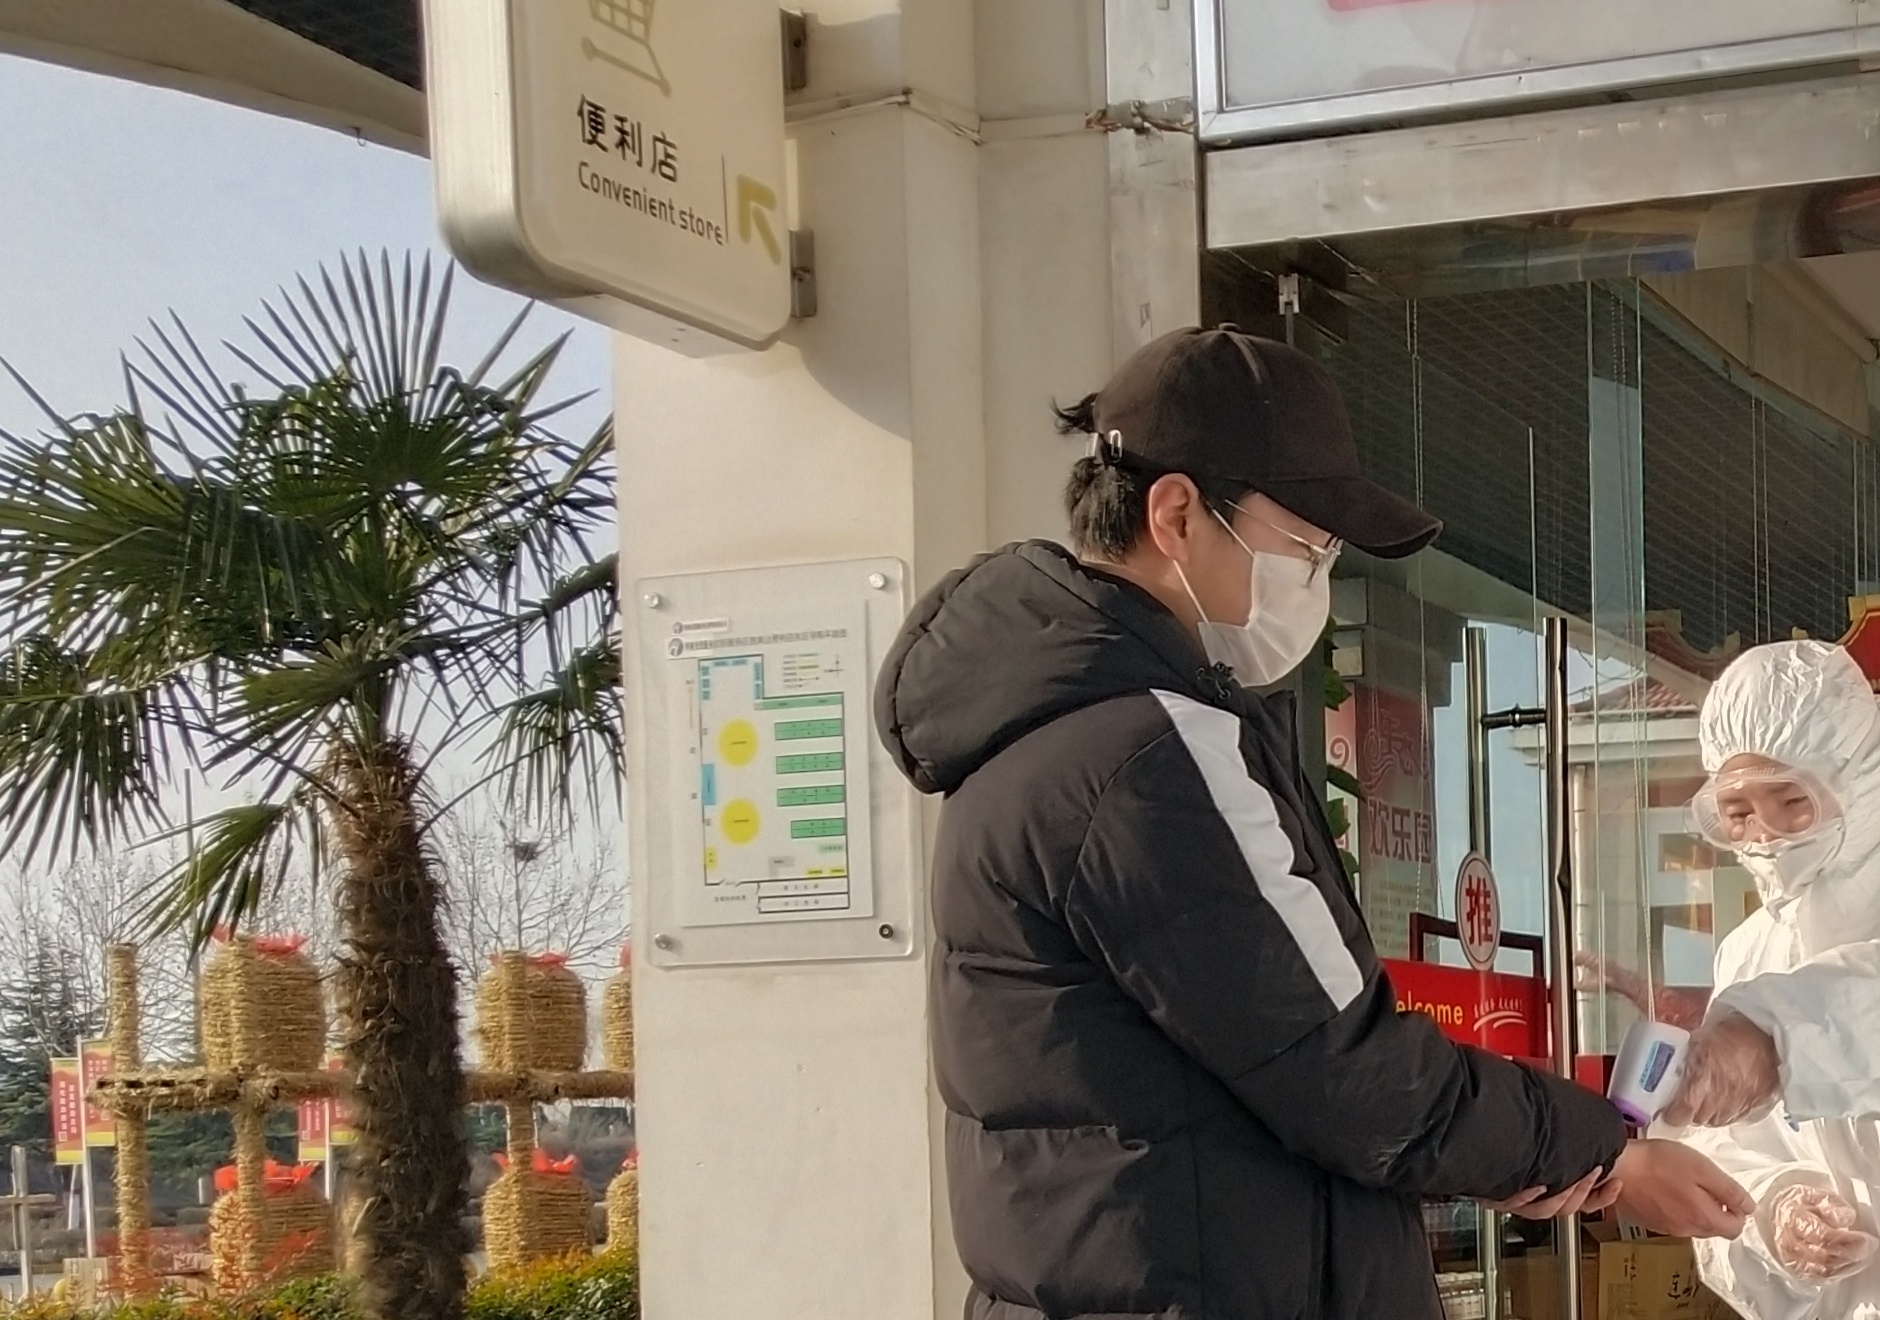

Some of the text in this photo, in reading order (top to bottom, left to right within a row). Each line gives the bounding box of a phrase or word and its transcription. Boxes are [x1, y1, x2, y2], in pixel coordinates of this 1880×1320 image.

[576, 94, 679, 183] 便利店
[578, 162, 725, 246] Convenient store
[1465, 874, 1494, 947] 推
[1395, 990, 1463, 1026] elcome
